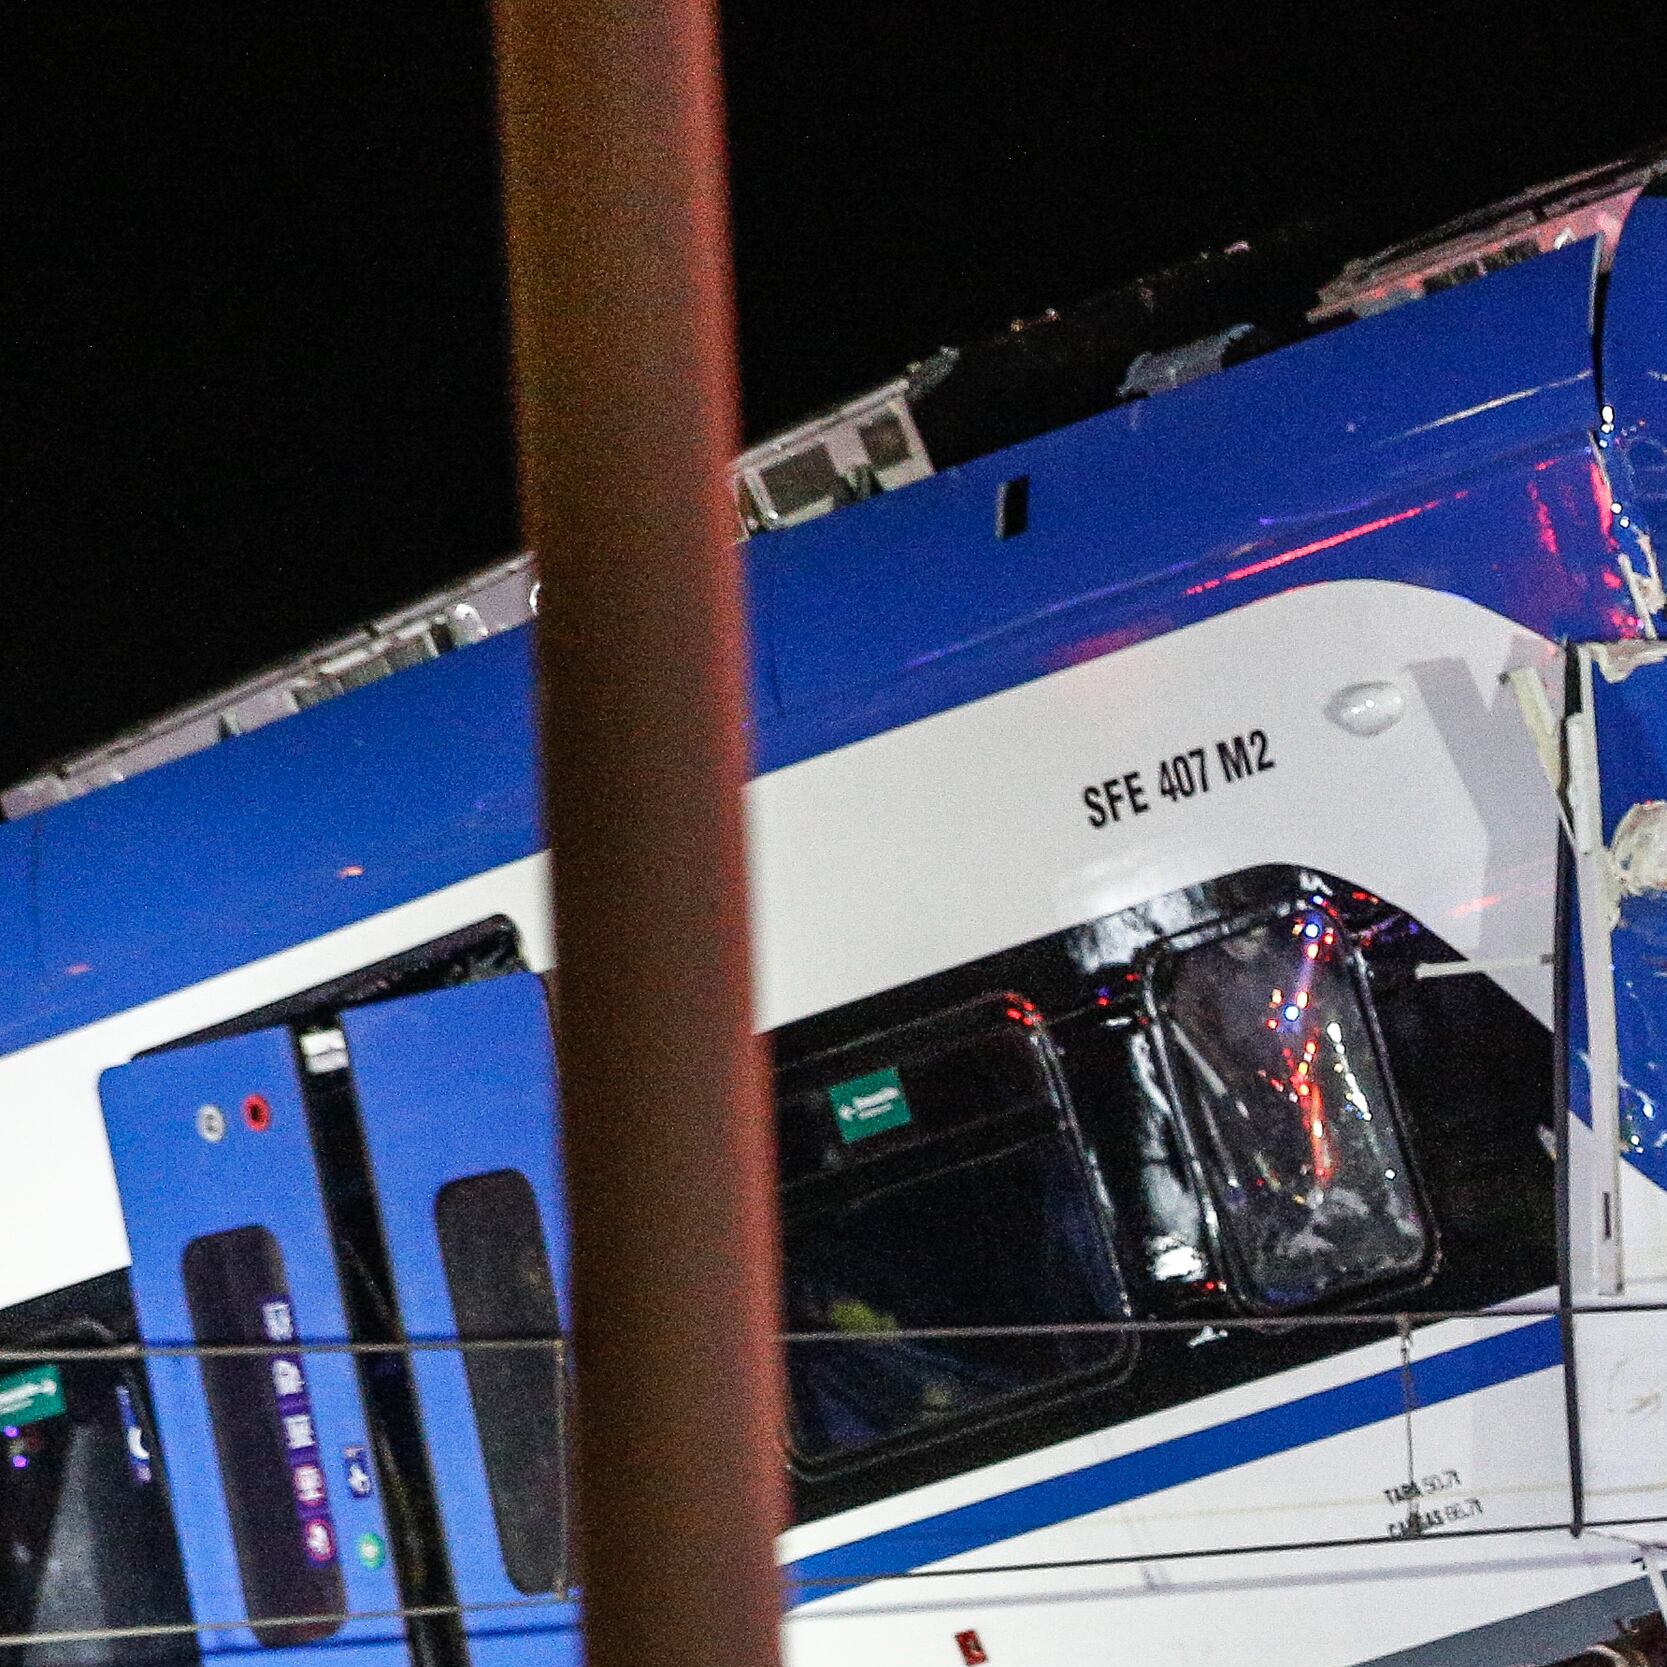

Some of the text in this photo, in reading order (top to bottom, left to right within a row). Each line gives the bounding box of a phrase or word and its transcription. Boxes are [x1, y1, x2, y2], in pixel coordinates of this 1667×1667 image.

[1082, 728, 1275, 829] SFE 407 M2
